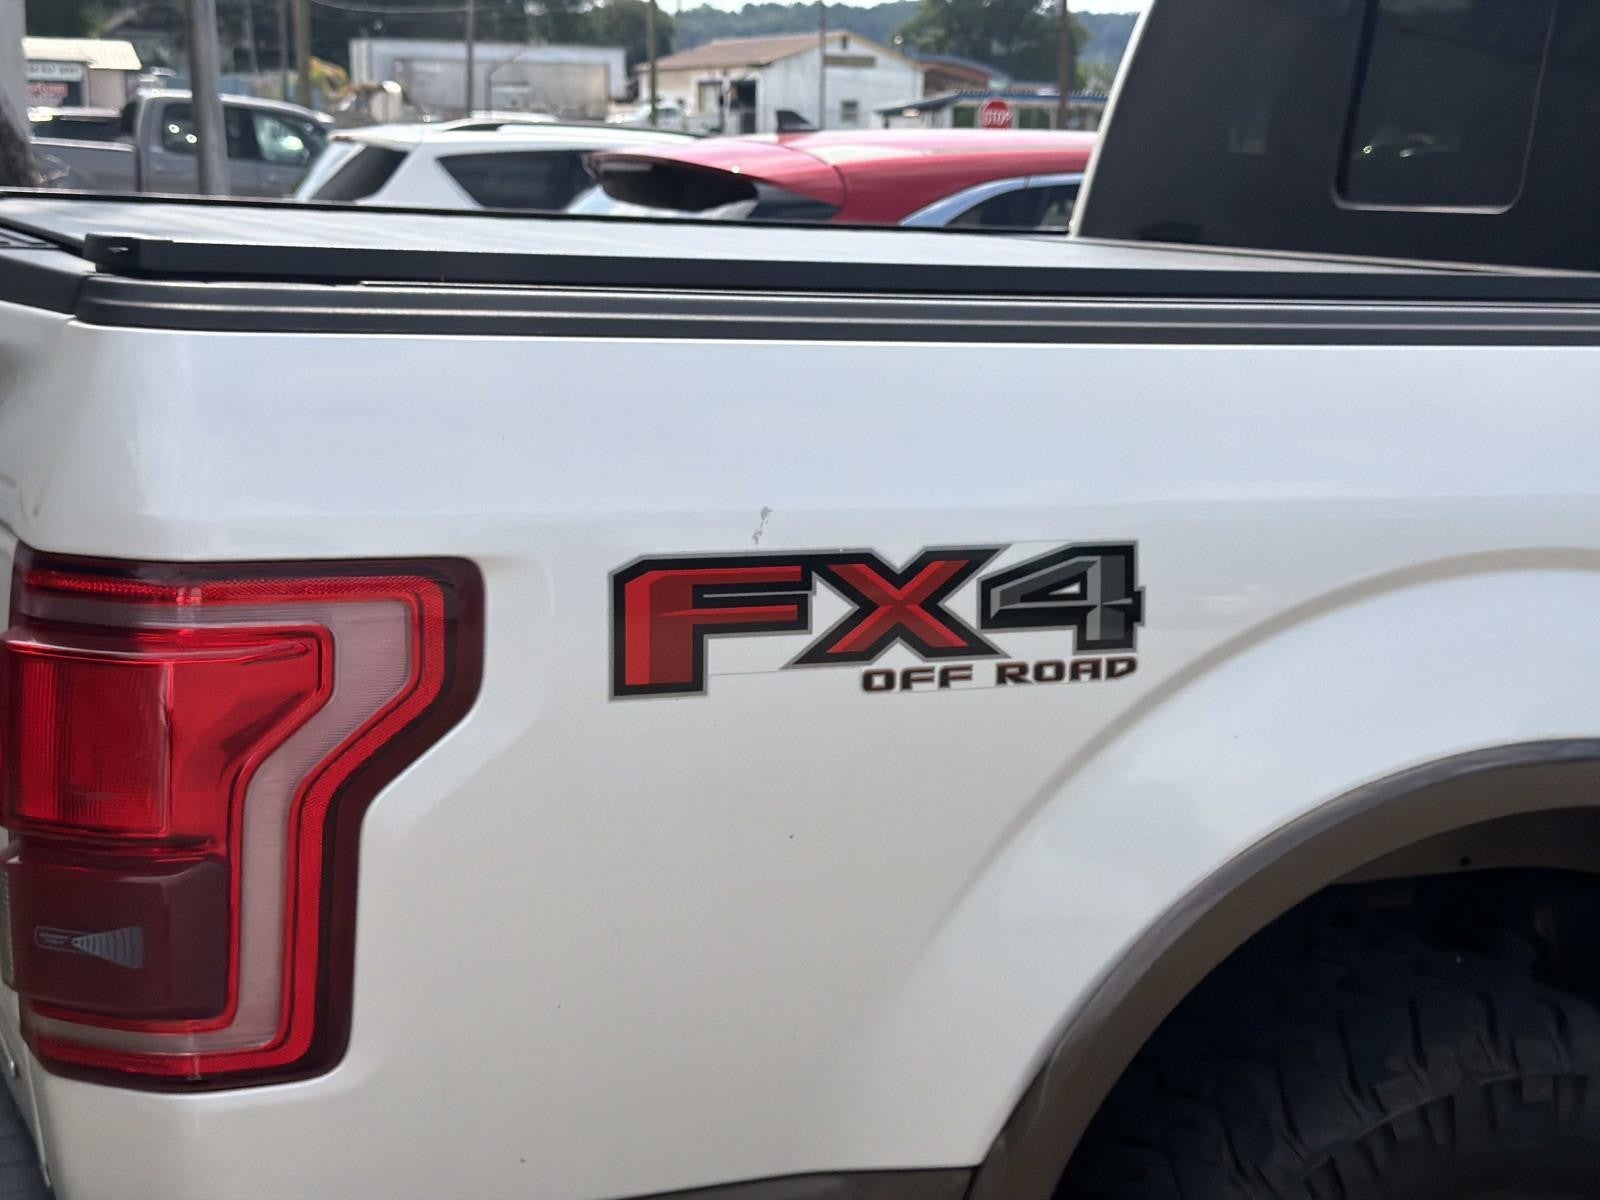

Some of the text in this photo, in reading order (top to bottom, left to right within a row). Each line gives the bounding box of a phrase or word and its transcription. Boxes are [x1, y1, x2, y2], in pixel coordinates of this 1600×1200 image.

[609, 540, 1145, 700] FX4
[862, 656, 1137, 693] OFF ROAD
